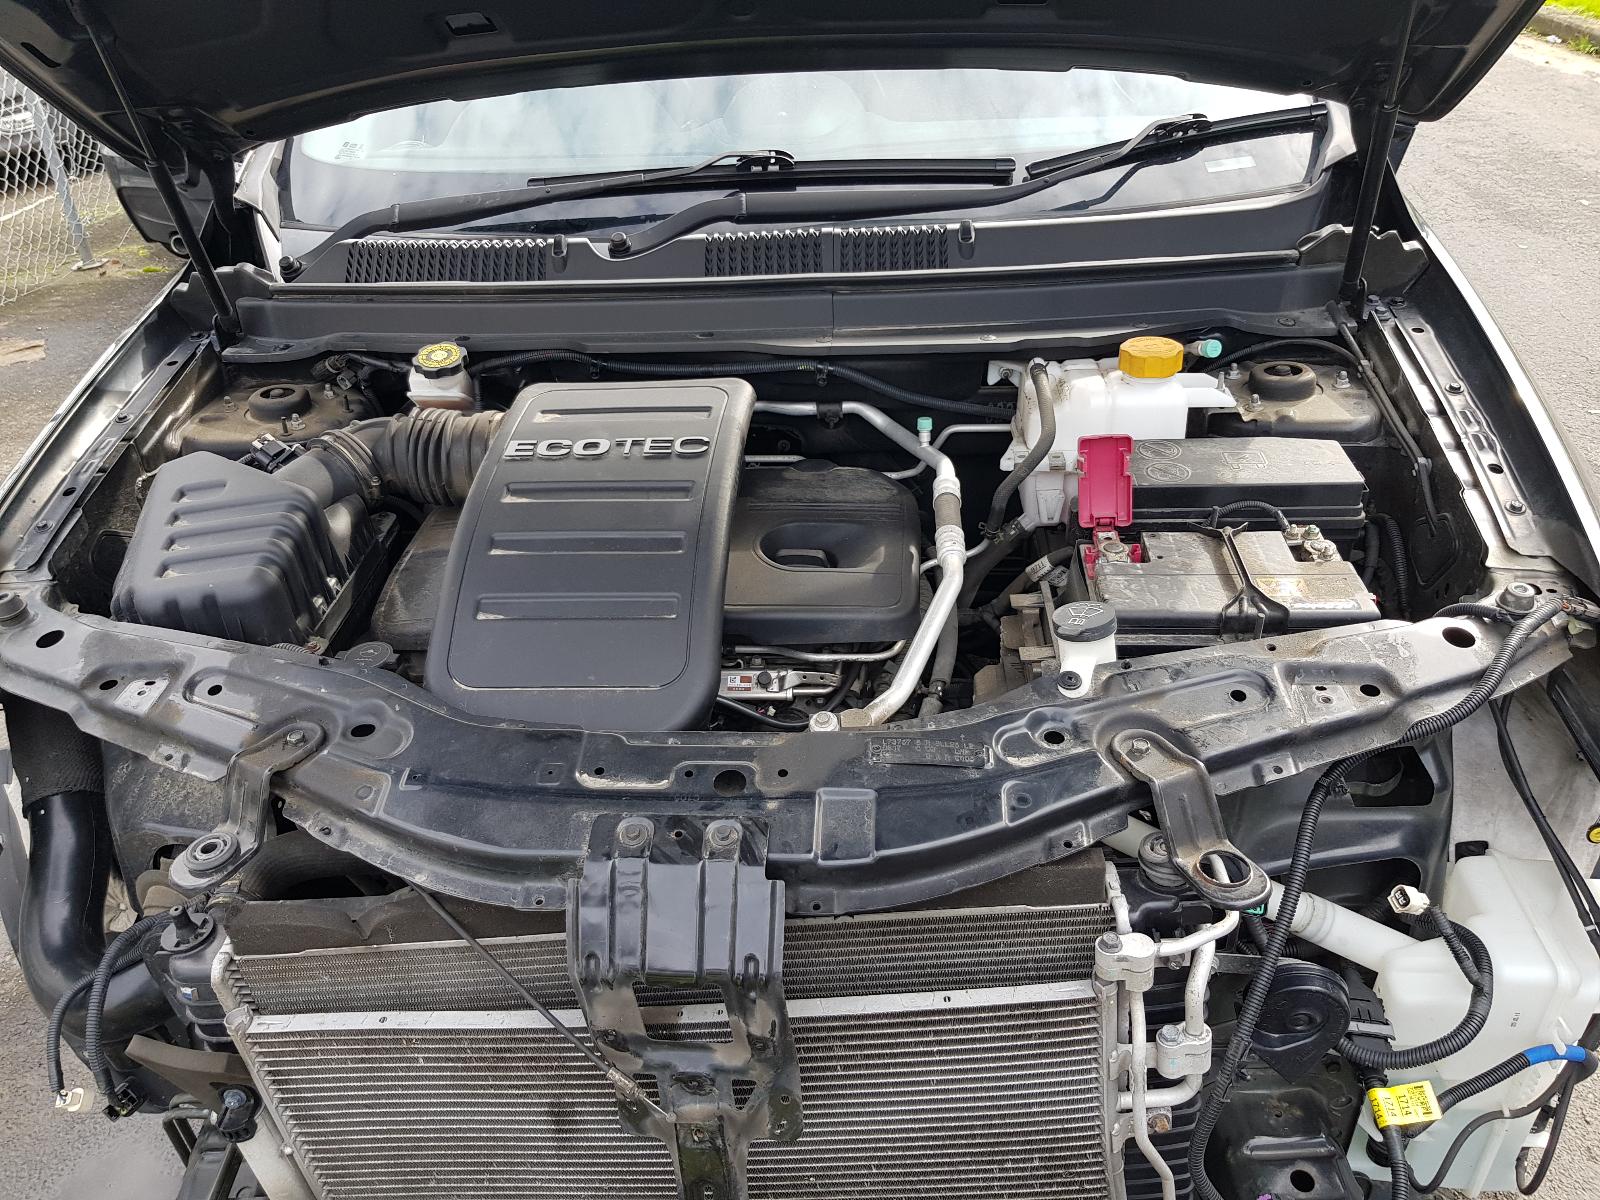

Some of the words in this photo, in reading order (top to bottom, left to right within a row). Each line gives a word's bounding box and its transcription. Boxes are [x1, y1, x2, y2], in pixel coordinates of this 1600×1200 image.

[504, 436, 711, 458] ECOTEC
[1371, 1098, 1384, 1120] 1714
[1384, 1096, 1397, 1117] 1714
[1398, 1094, 1412, 1115] 1714
